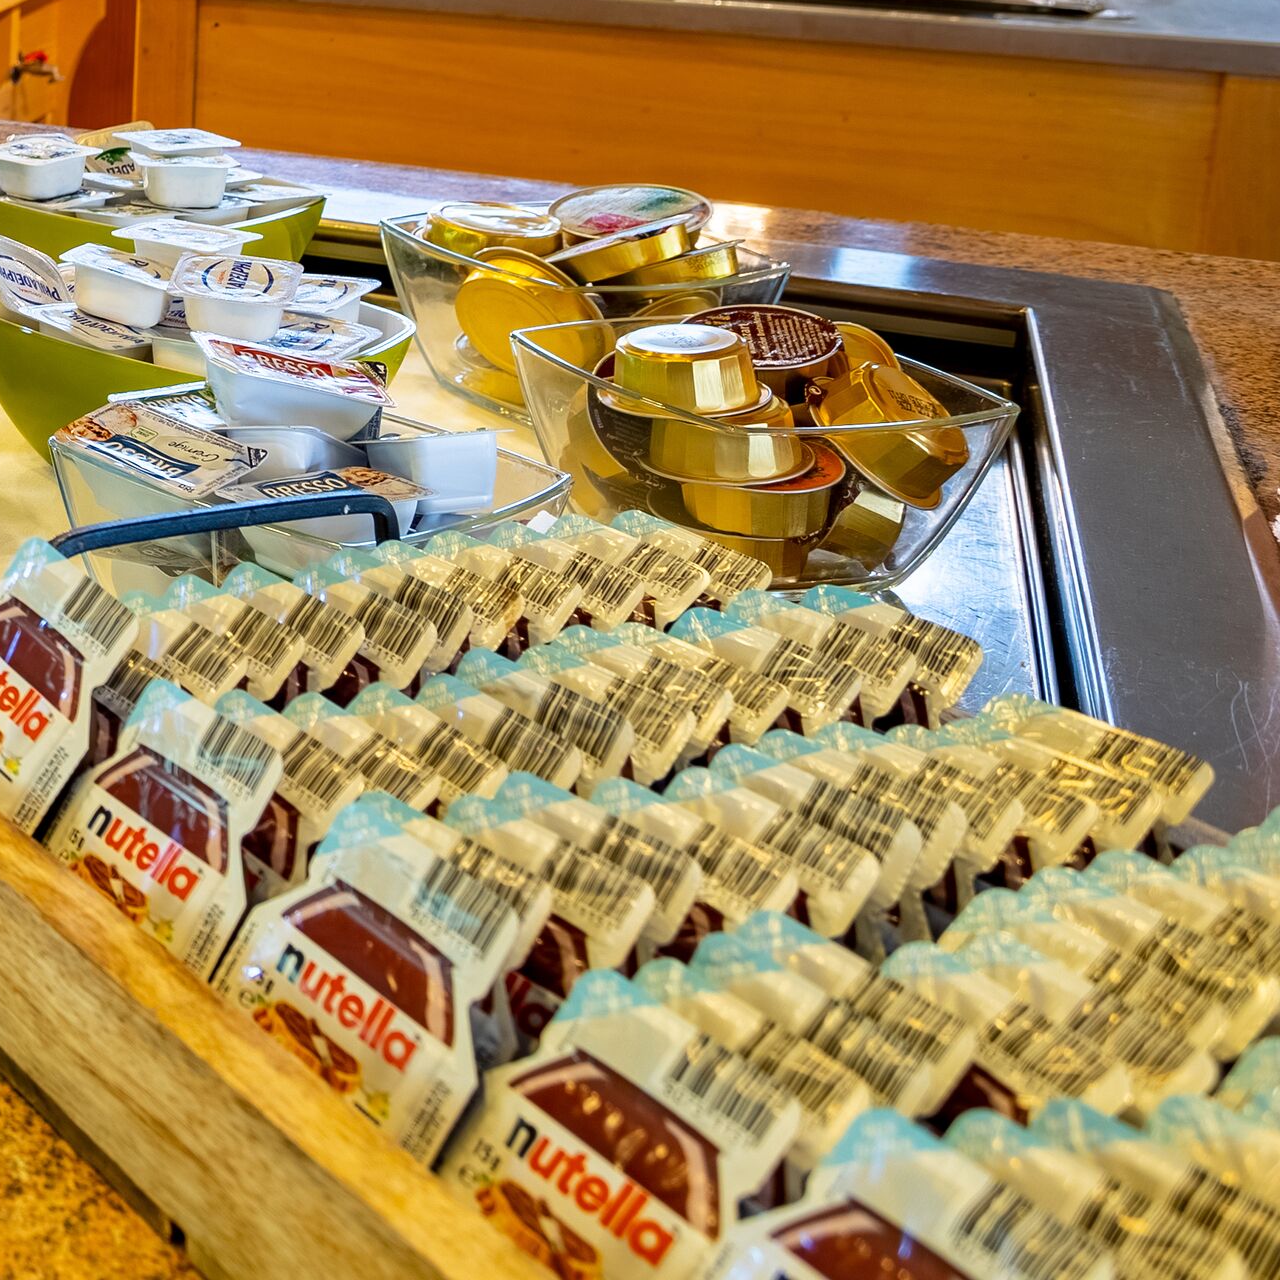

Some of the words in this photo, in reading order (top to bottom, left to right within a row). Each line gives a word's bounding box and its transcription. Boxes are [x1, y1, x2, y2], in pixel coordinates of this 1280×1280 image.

[262, 476, 348, 500] BRESSO
[87, 804, 201, 903] nutella
[276, 943, 419, 1072] nutella
[505, 1116, 675, 1268] nutella
